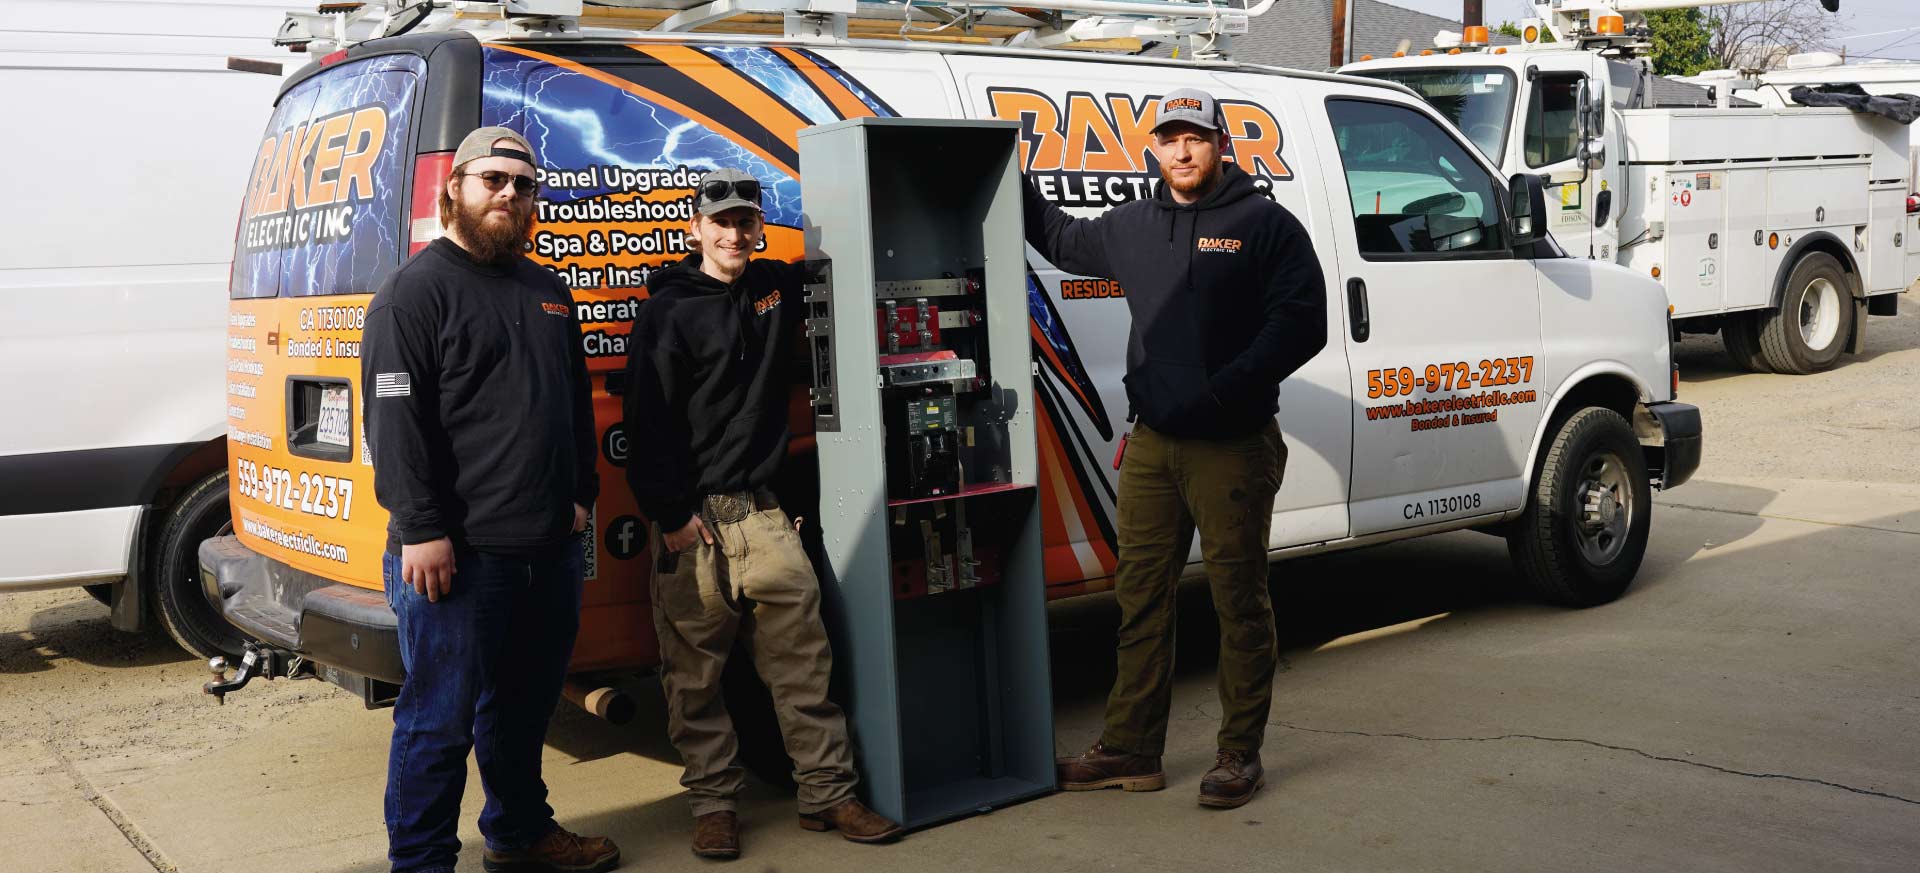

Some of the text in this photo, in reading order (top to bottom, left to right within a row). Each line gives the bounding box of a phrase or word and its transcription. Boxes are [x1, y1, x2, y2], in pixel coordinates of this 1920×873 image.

[988, 88, 1292, 179] BAKR
[247, 107, 387, 216] BAKER
[537, 198, 694, 221] Troubleshooti
[247, 205, 353, 248] ELECTRIC INC
[538, 233, 582, 259] Spa
[589, 233, 605, 253] &
[611, 231, 661, 252] Pool
[1198, 238, 1242, 250] BAKER
[301, 306, 365, 331] CA 1130108
[287, 338, 360, 358] Bonded & Insu
[1367, 356, 1533, 399] 559-972-2237
[1366, 389, 1537, 420] www.bakerelectricllc.com
[1411, 409, 1497, 431] Bonded & Insured
[238, 457, 353, 521] 559-972-2237
[1403, 493, 1481, 520] CA 1130108
[242, 518, 349, 564] www.bakerelectricllc.com
